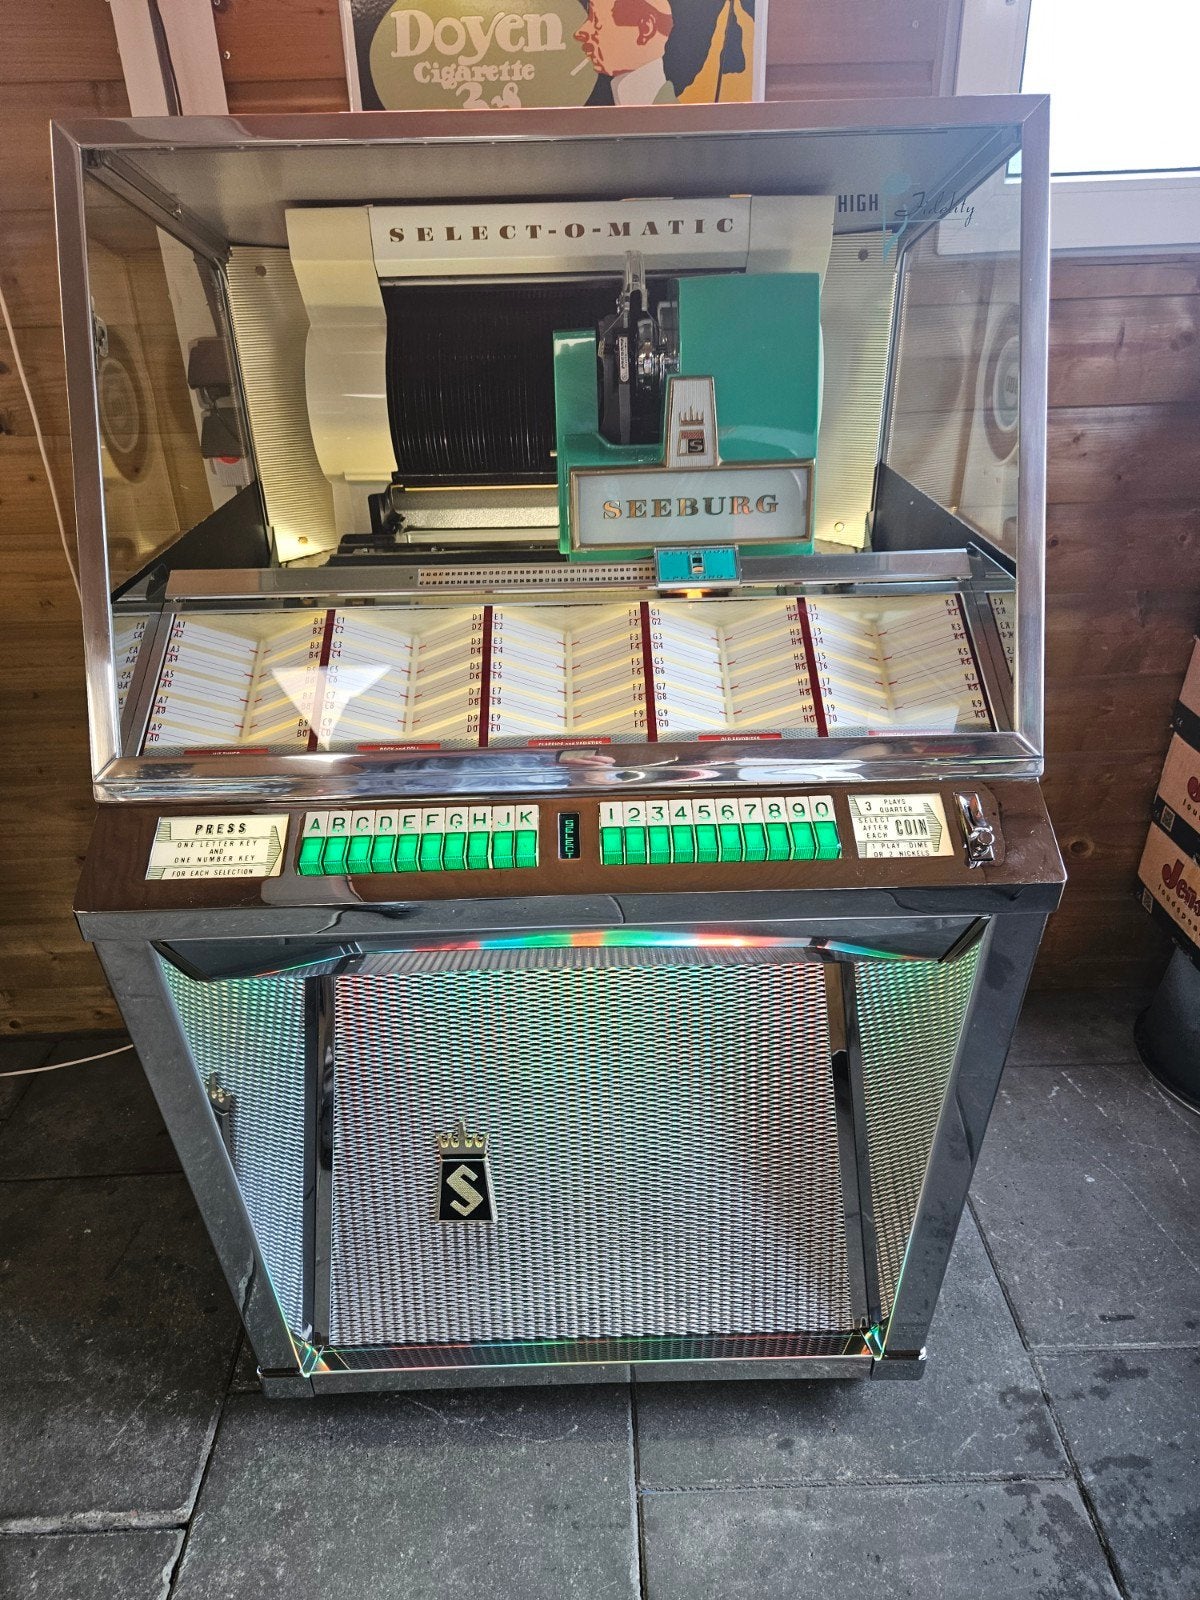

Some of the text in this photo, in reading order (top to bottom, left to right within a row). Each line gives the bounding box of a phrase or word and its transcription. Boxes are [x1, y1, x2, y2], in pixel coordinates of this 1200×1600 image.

[390, 9, 566, 66] Doyen
[413, 60, 535, 90] Cigarette
[838, 194, 879, 212] HIGH
[389, 217, 735, 243] SELECT-O-MATIC
[603, 494, 779, 520] SEEBURG
[628, 808, 640, 822] 2
[652, 806, 664, 822] 3
[675, 806, 687, 819] 4
[699, 805, 710, 820] 5
[722, 805, 734, 820] 6
[745, 804, 757, 818] 7
[769, 803, 781, 819] 8
[793, 803, 805, 818] 9
[816, 802, 828, 818] 0
[866, 801, 872, 812] 3
[195, 823, 246, 835] PRESS
[309, 811, 533, 832] A B C D E F G H J K
[895, 819, 928, 835] COIN
[565, 819, 574, 859] SELECT
[214, 868, 254, 876] SELECTION
[446, 1164, 484, 1217] S
